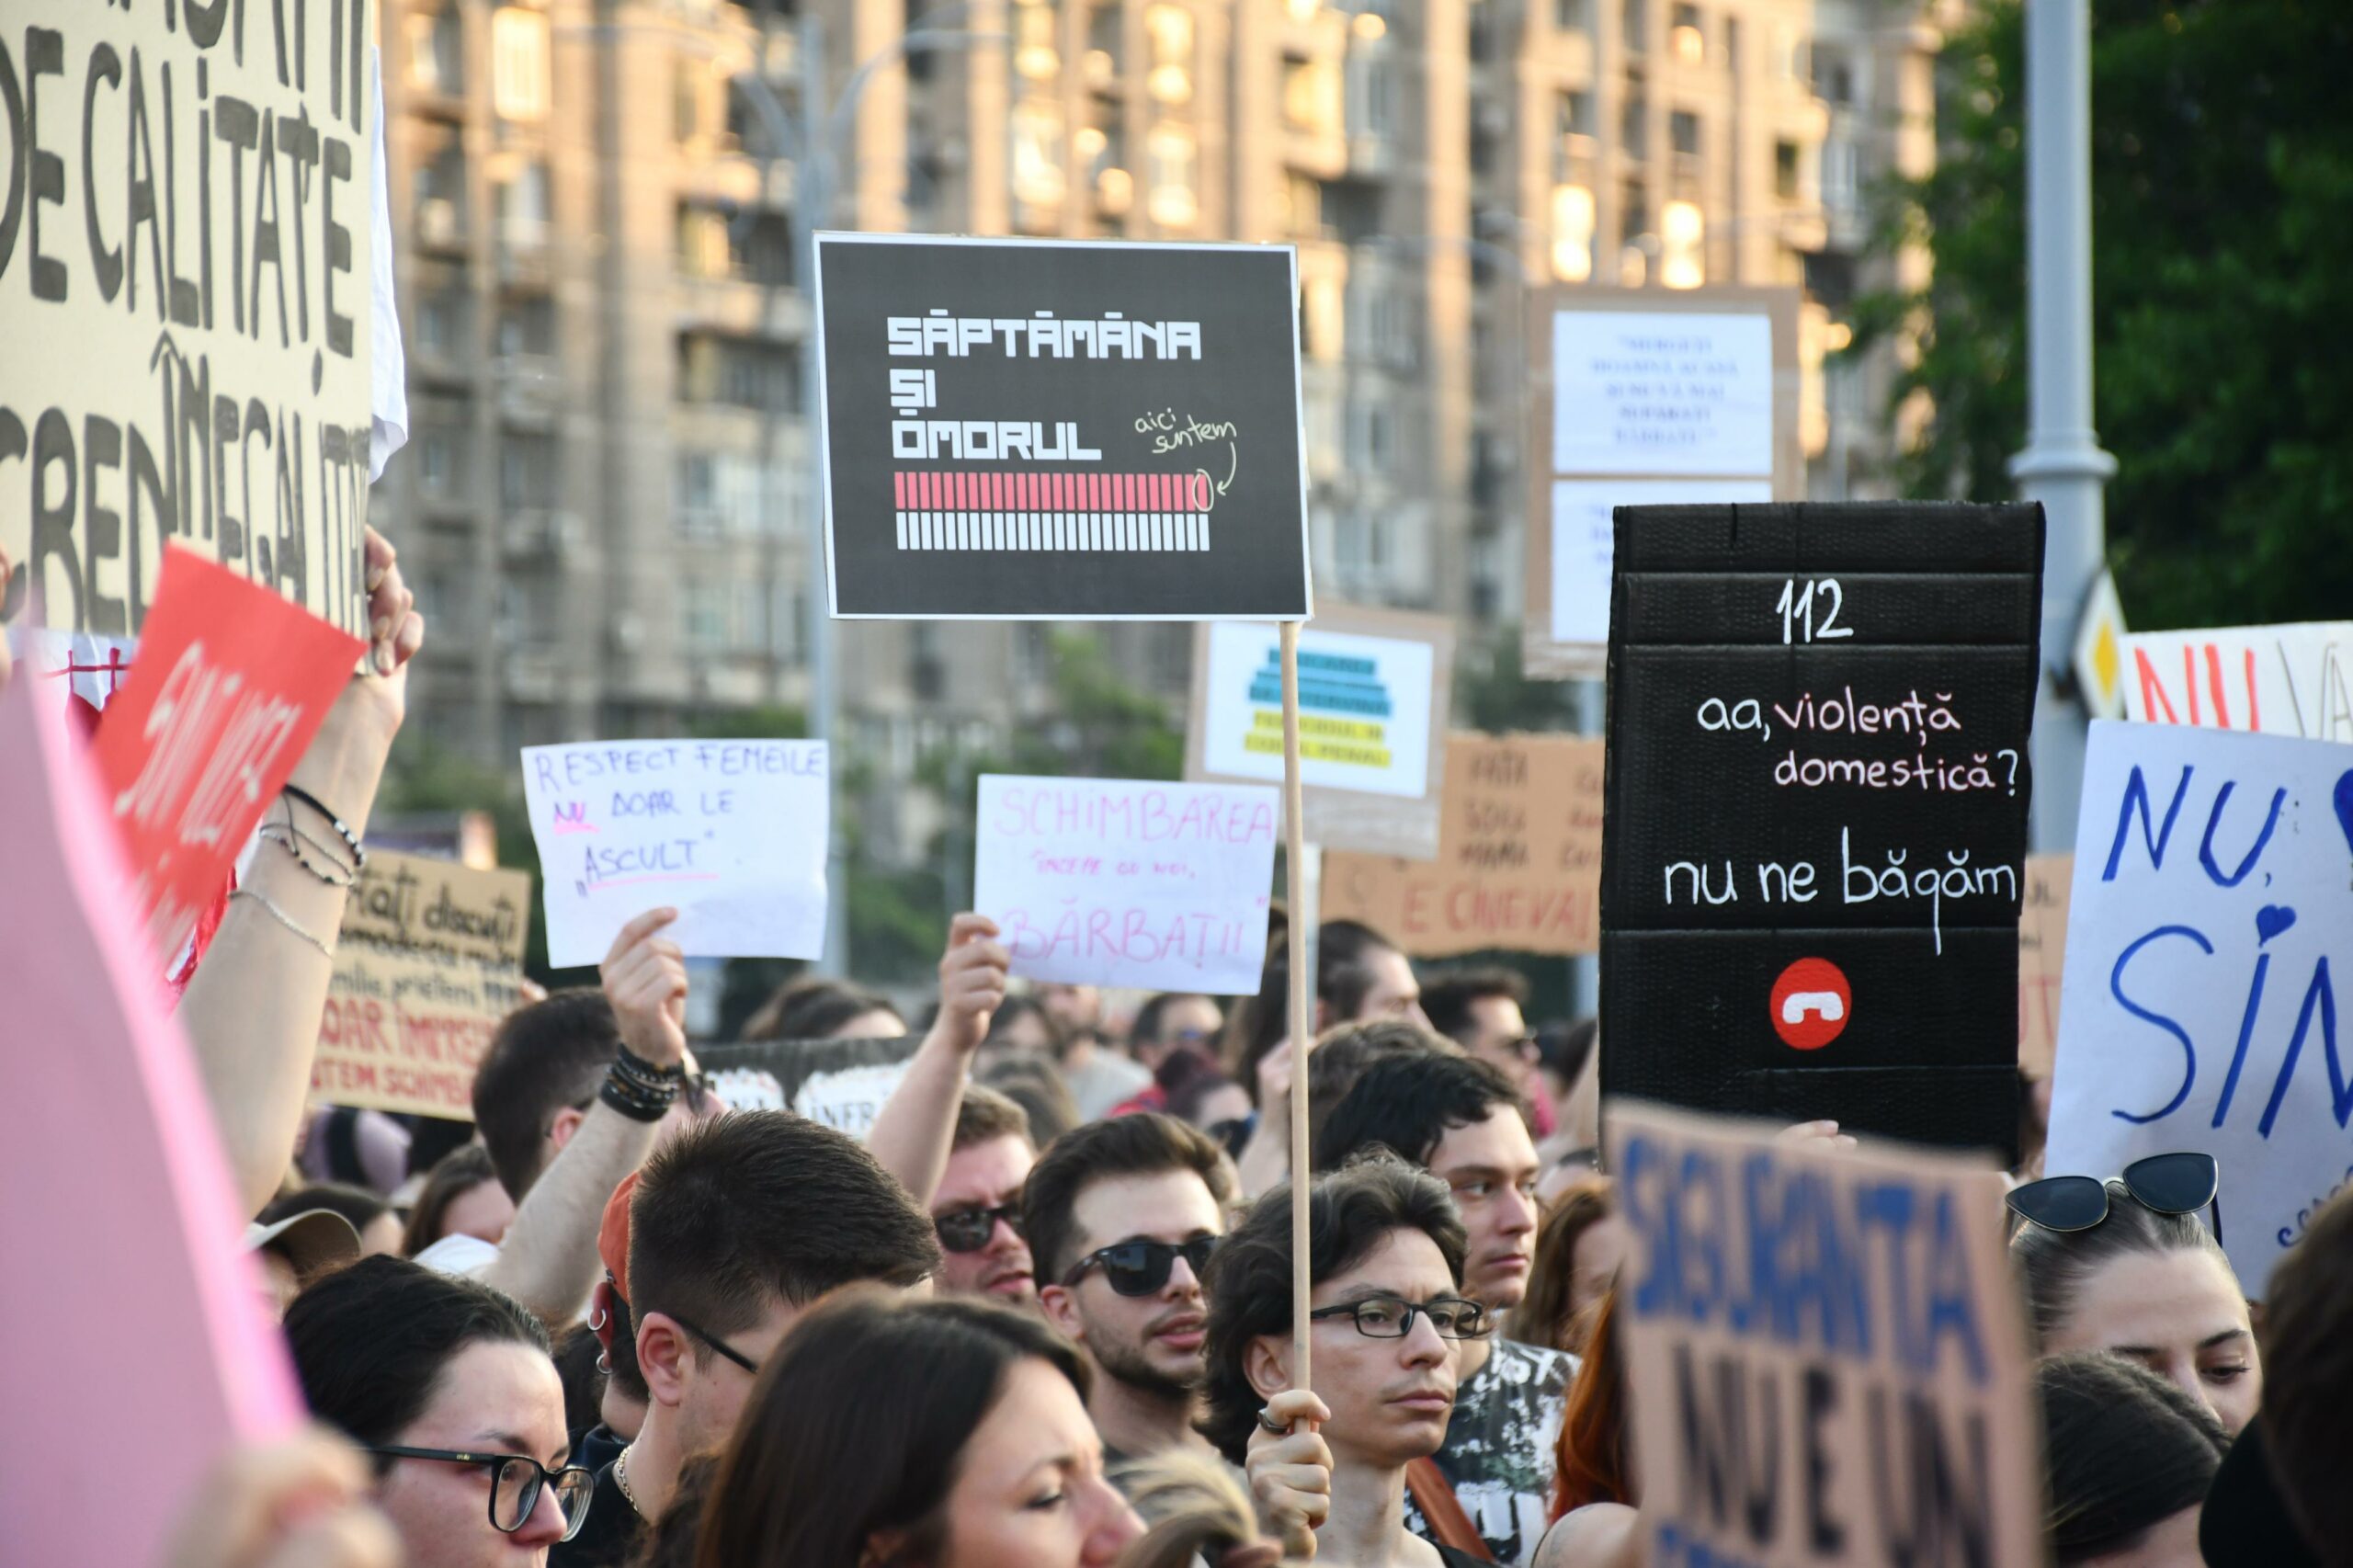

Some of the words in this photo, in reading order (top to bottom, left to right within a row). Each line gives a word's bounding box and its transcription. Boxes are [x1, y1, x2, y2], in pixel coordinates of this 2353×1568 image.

[1135, 407, 1176, 433] aici
[1152, 414, 1236, 453] suntem
[1776, 579, 1853, 643] 112
[1697, 698, 1771, 741] aa,
[1775, 686, 1961, 745] violență
[535, 747, 678, 793] RESPECT
[1775, 748, 2018, 796] domestică?
[610, 790, 679, 818] DOAR
[700, 790, 734, 815] LE
[994, 787, 1274, 843] SCHIMBAREA
[1665, 859, 1738, 905] nu
[1758, 861, 1819, 903] ne
